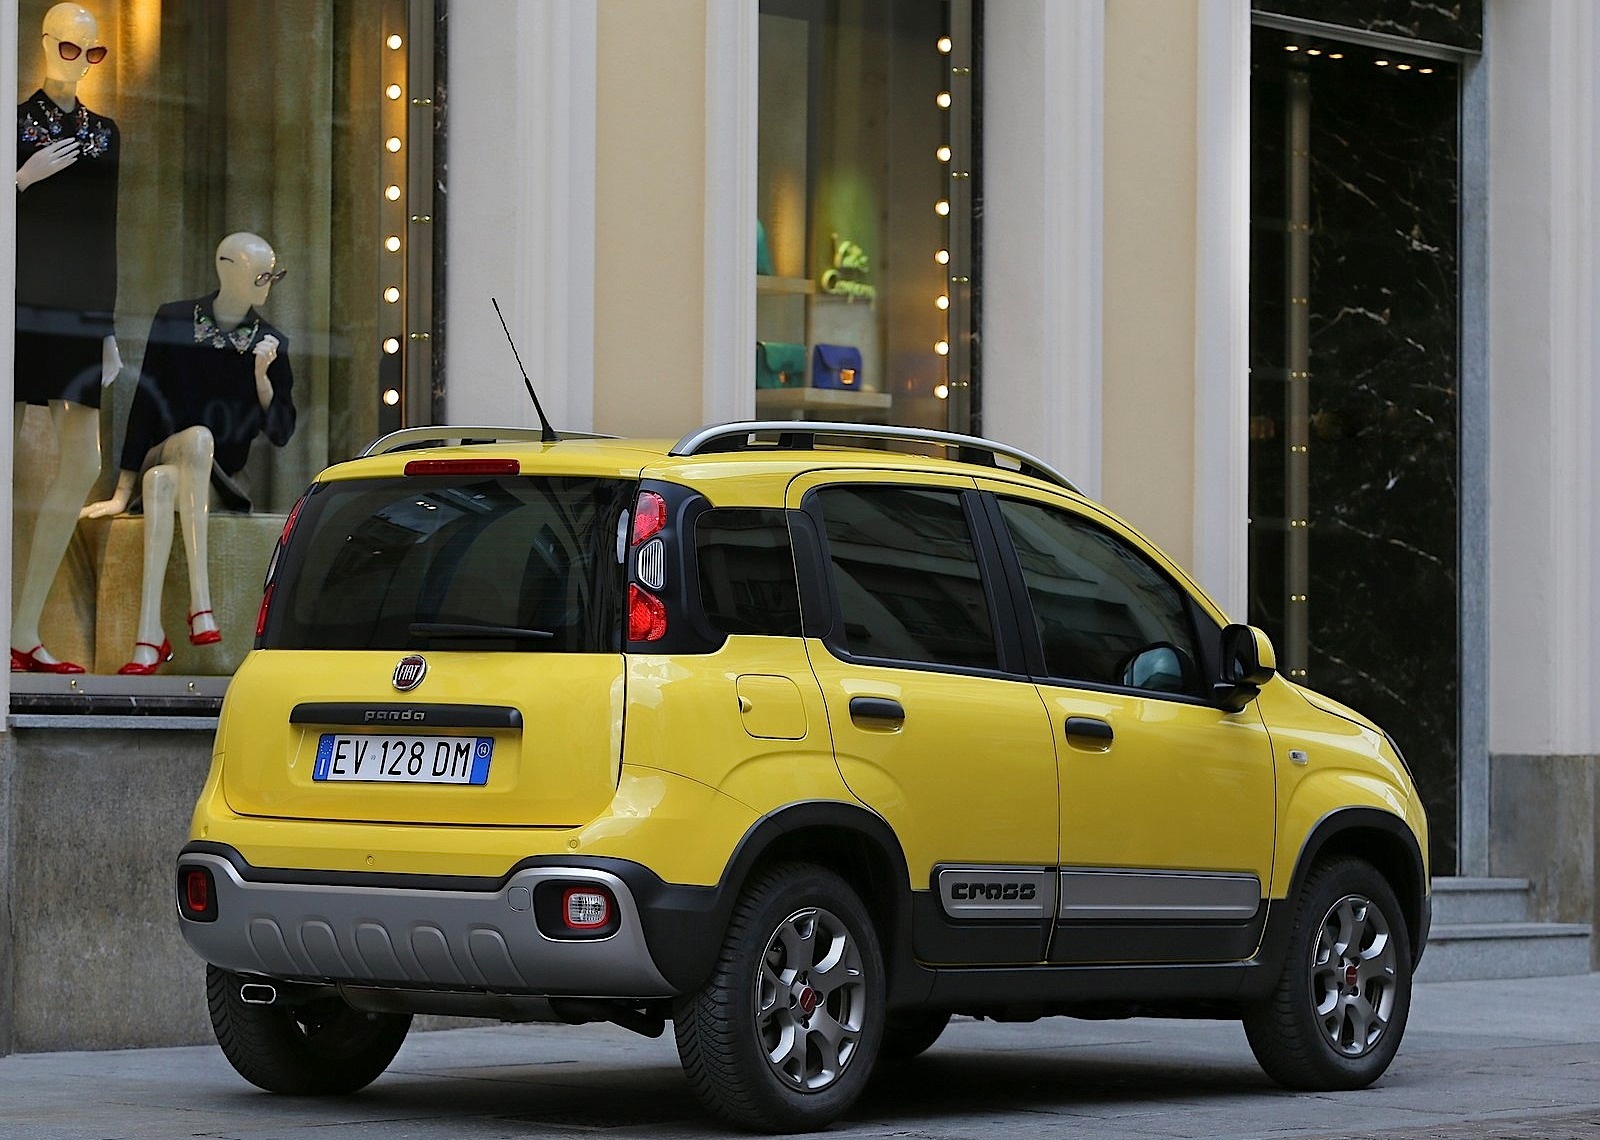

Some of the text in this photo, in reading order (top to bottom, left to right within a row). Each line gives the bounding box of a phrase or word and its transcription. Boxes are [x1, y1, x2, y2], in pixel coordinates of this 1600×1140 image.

[398, 664, 420, 680] FIAT
[365, 709, 425, 721] panda
[332, 740, 471, 777] EV 128 DM
